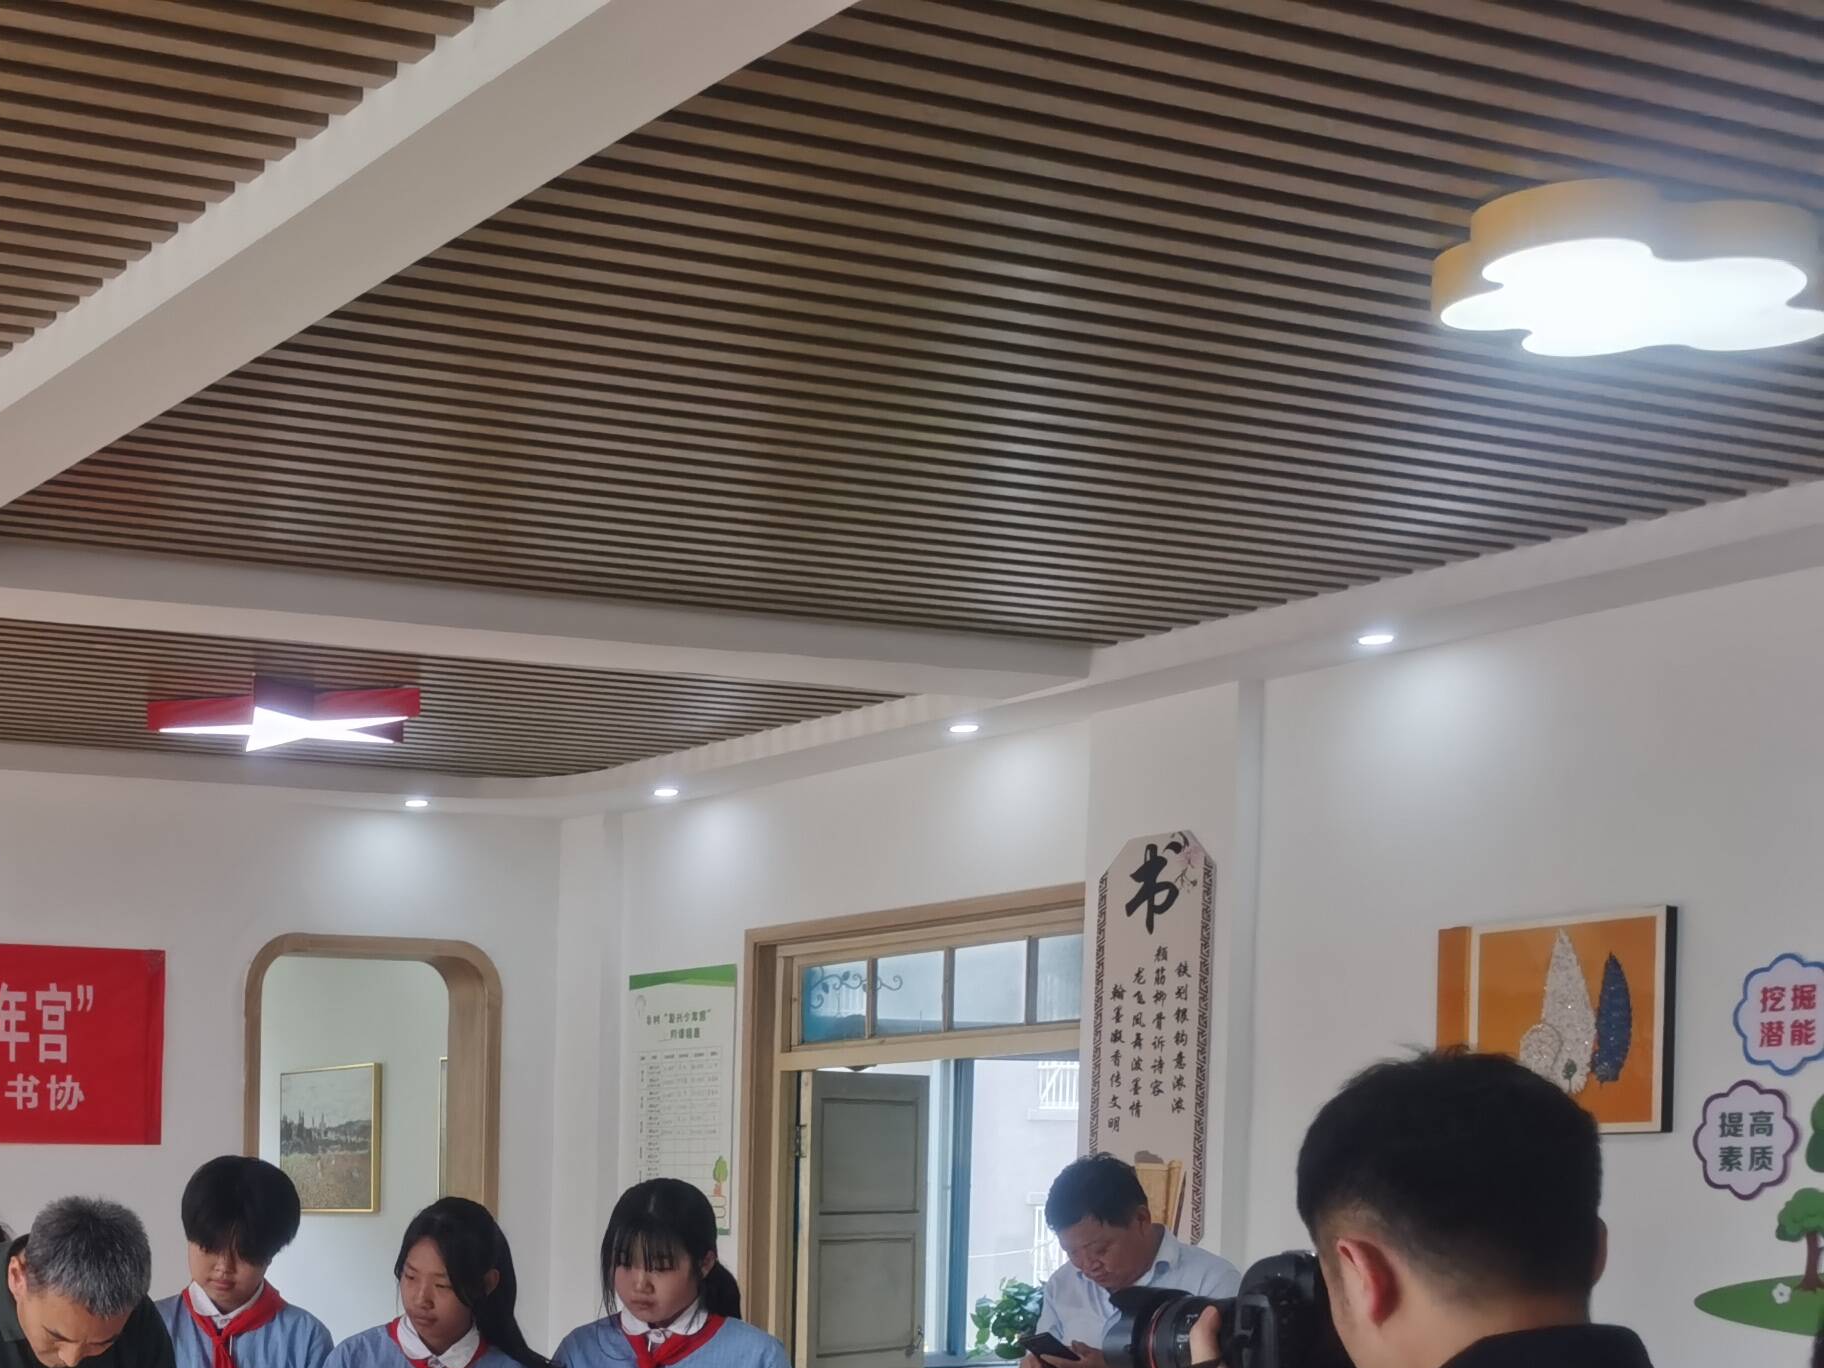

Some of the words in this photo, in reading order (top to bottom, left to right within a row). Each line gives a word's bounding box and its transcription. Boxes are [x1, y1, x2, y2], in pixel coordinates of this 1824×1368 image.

[1125, 843, 1179, 935] 书
[1759, 984, 1818, 1014] 挖掘
[1759, 1018, 1817, 1048] 潜能
[1717, 1110, 1775, 1138] 提高
[1717, 1144, 1774, 1172] 素质
